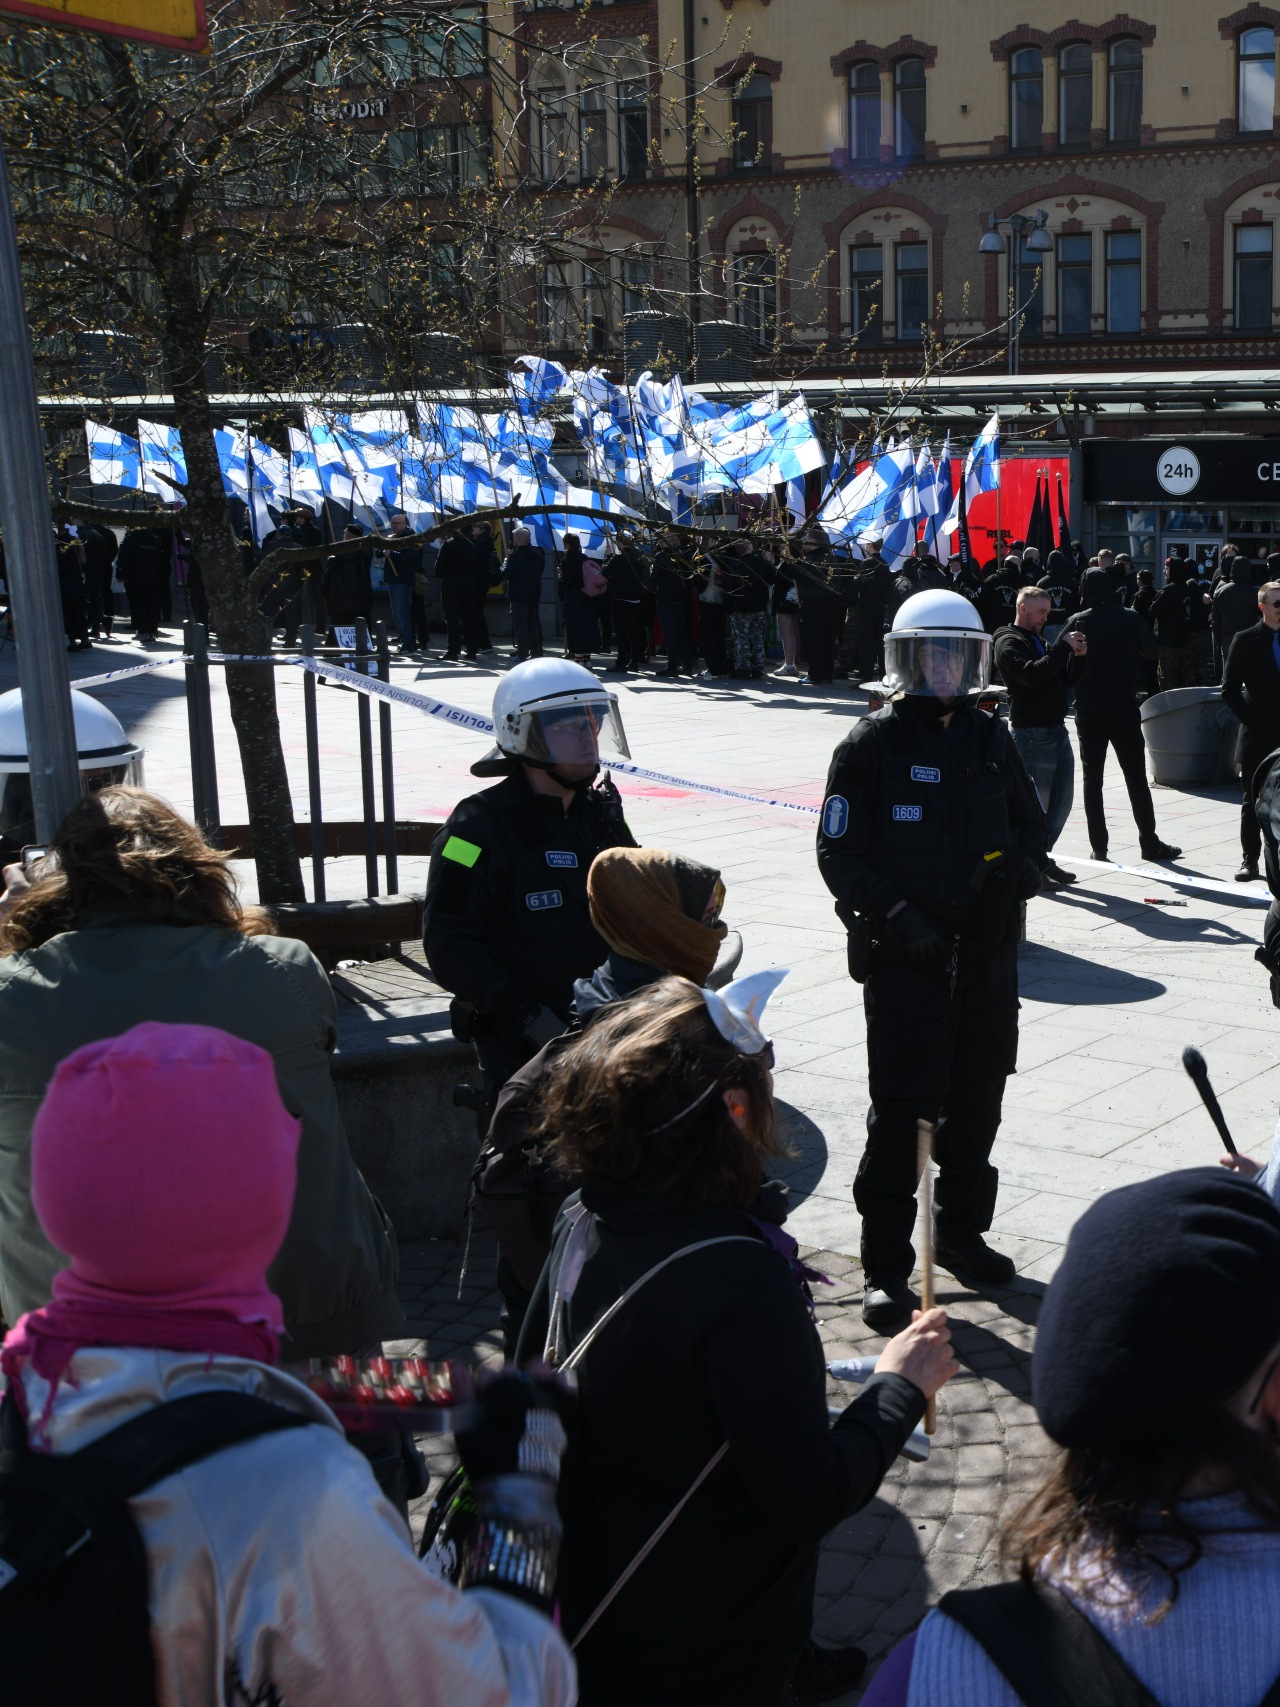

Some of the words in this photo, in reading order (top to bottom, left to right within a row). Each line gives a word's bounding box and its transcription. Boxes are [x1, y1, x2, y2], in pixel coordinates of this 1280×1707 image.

[1163, 463, 1194, 479] 24h
[446, 709, 494, 732] POLIISI
[914, 768, 937, 776] POLIISI
[895, 806, 920, 819] 1609
[530, 892, 559, 907] 611
